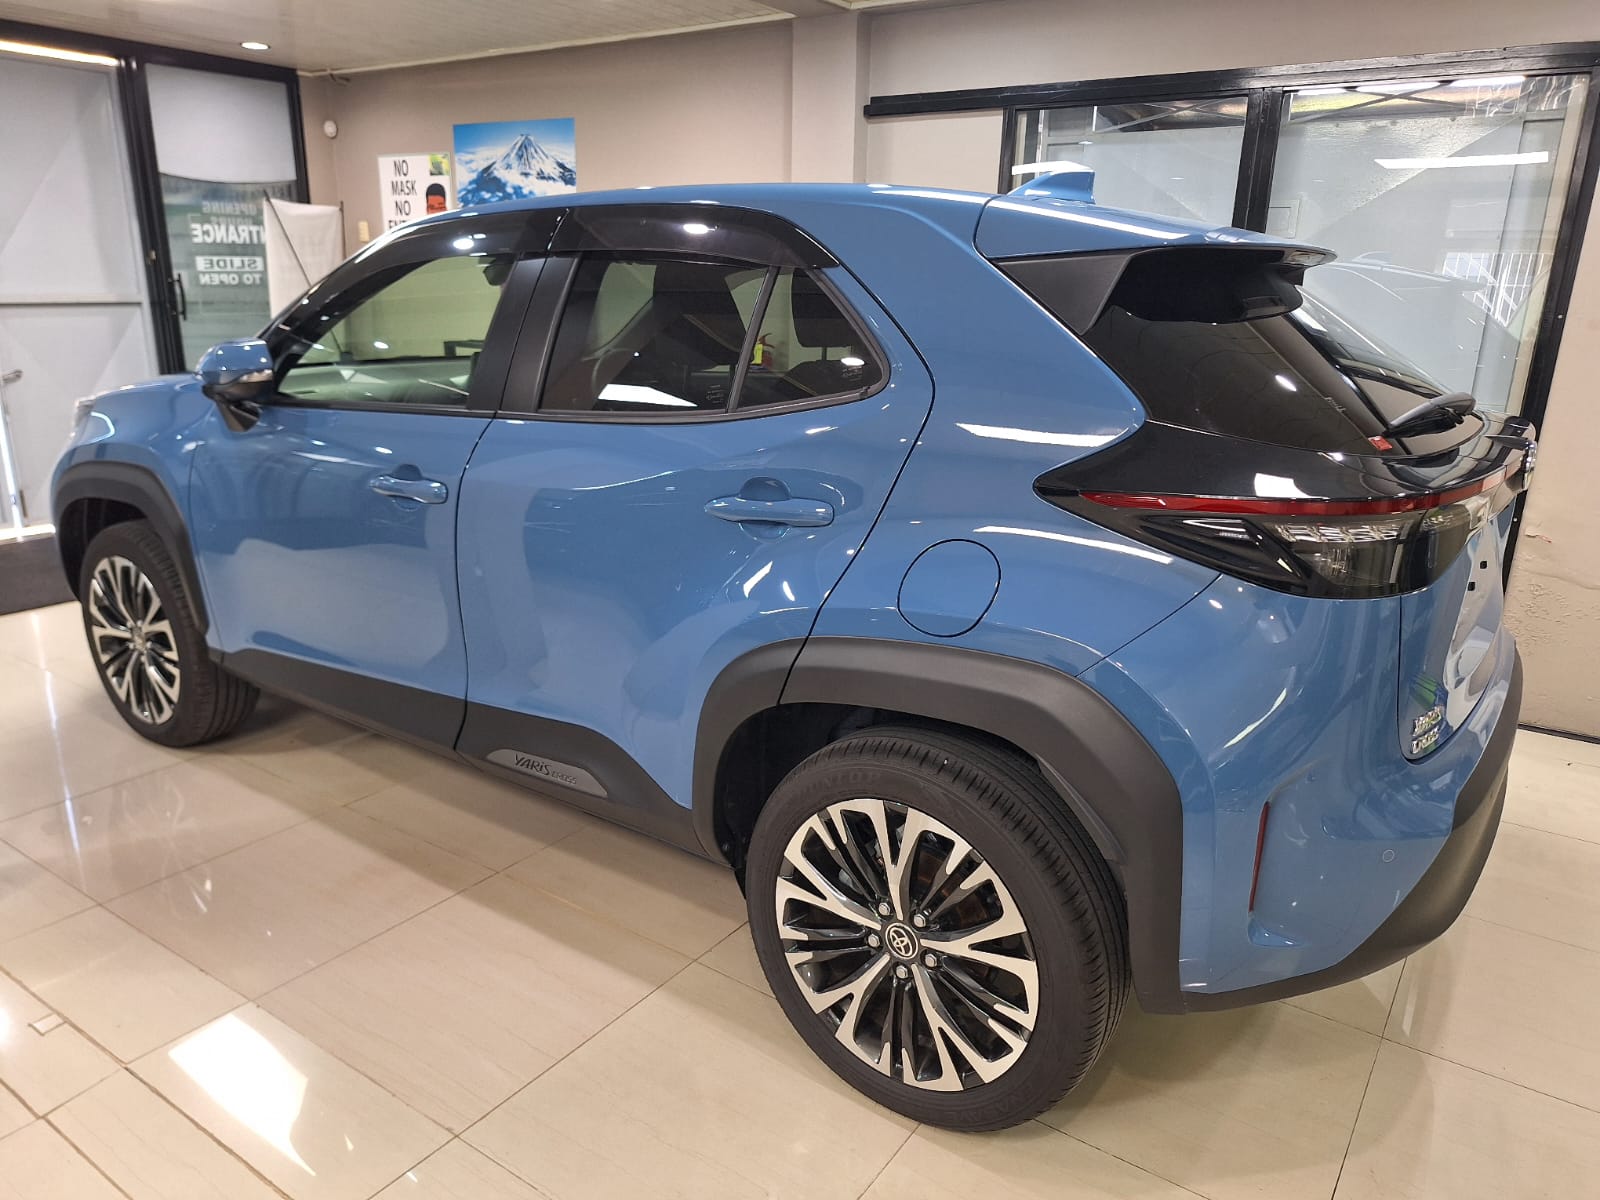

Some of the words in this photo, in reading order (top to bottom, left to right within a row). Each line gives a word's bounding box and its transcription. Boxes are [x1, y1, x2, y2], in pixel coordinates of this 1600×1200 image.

[393, 159, 409, 177] NO
[391, 180, 417, 196] MASK
[395, 200, 411, 216] NO
